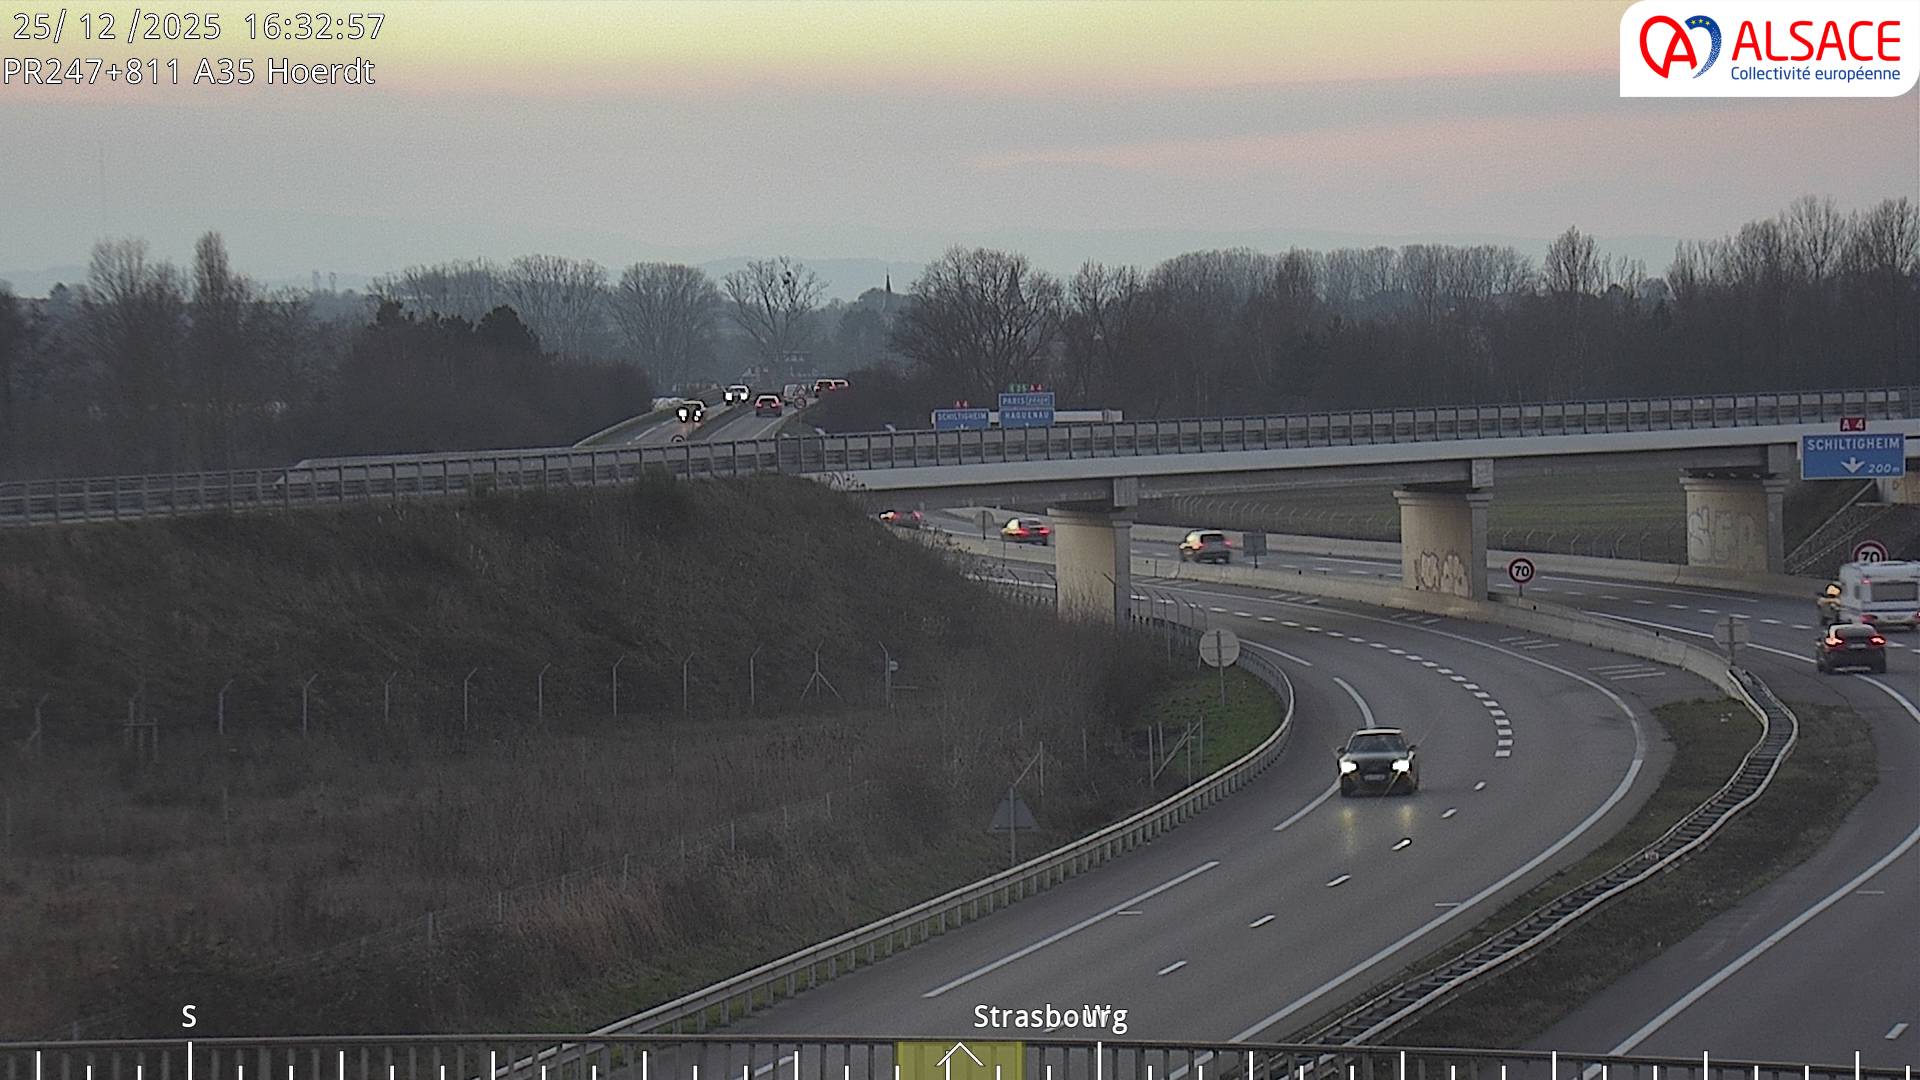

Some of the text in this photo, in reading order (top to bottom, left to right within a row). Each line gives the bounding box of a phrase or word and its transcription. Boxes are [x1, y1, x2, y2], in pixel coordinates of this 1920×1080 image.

[1002, 397, 1025, 405] PARIS
[1005, 411, 1050, 419] HAGUENAU
[1807, 438, 1900, 451] SCHILTIGHEIM
[1515, 566, 1529, 577] 70
